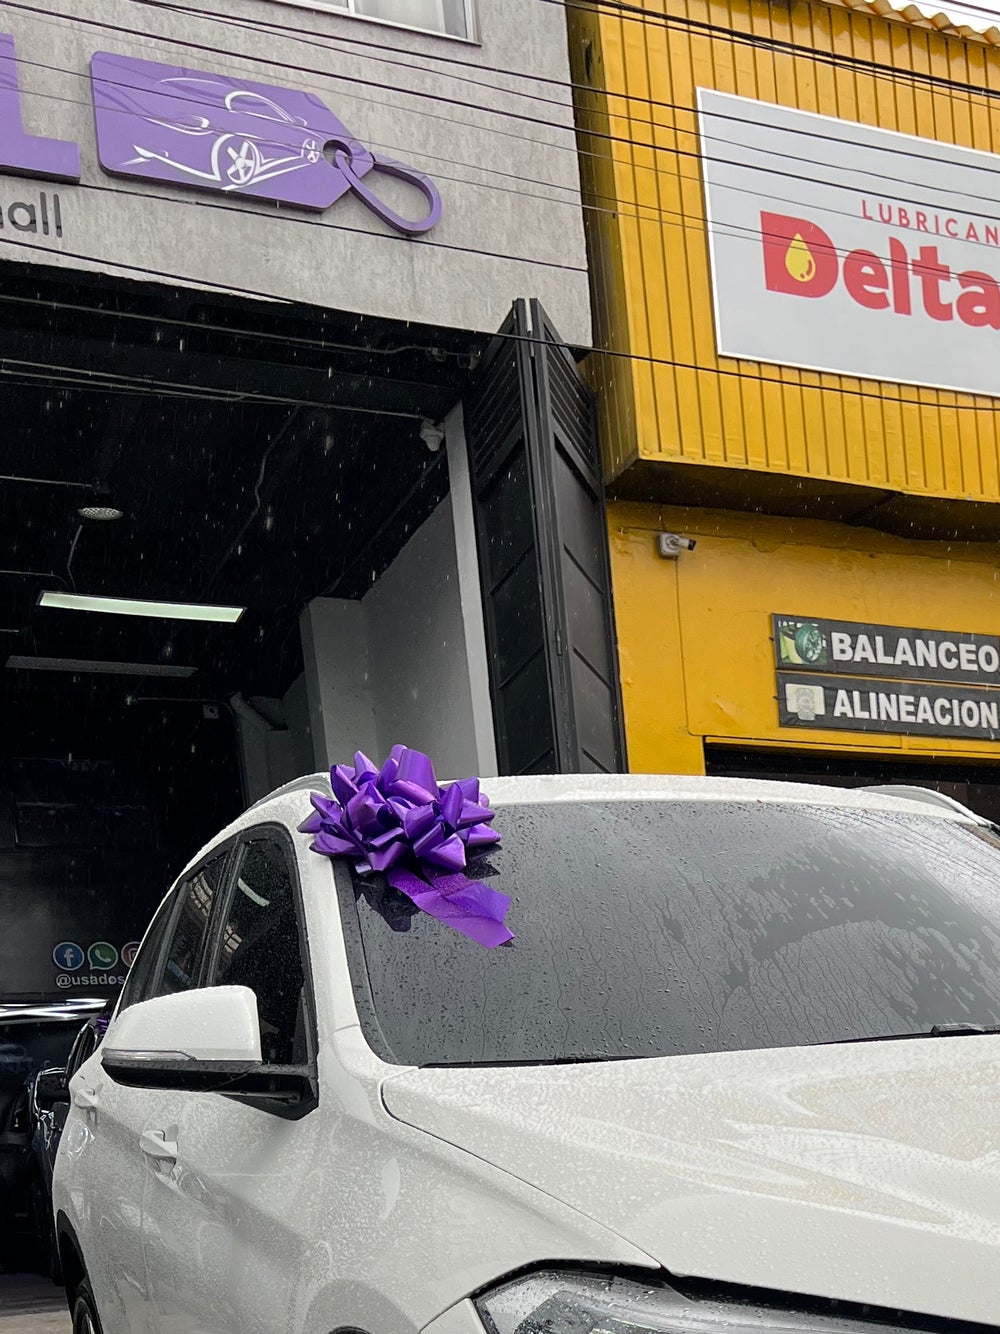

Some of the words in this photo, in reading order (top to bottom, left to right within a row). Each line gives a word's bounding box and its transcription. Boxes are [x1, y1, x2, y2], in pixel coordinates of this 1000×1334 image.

[0, 192, 63, 238] all
[831, 632, 999, 673] BALANCEO
[834, 689, 998, 729] ALINEACION
